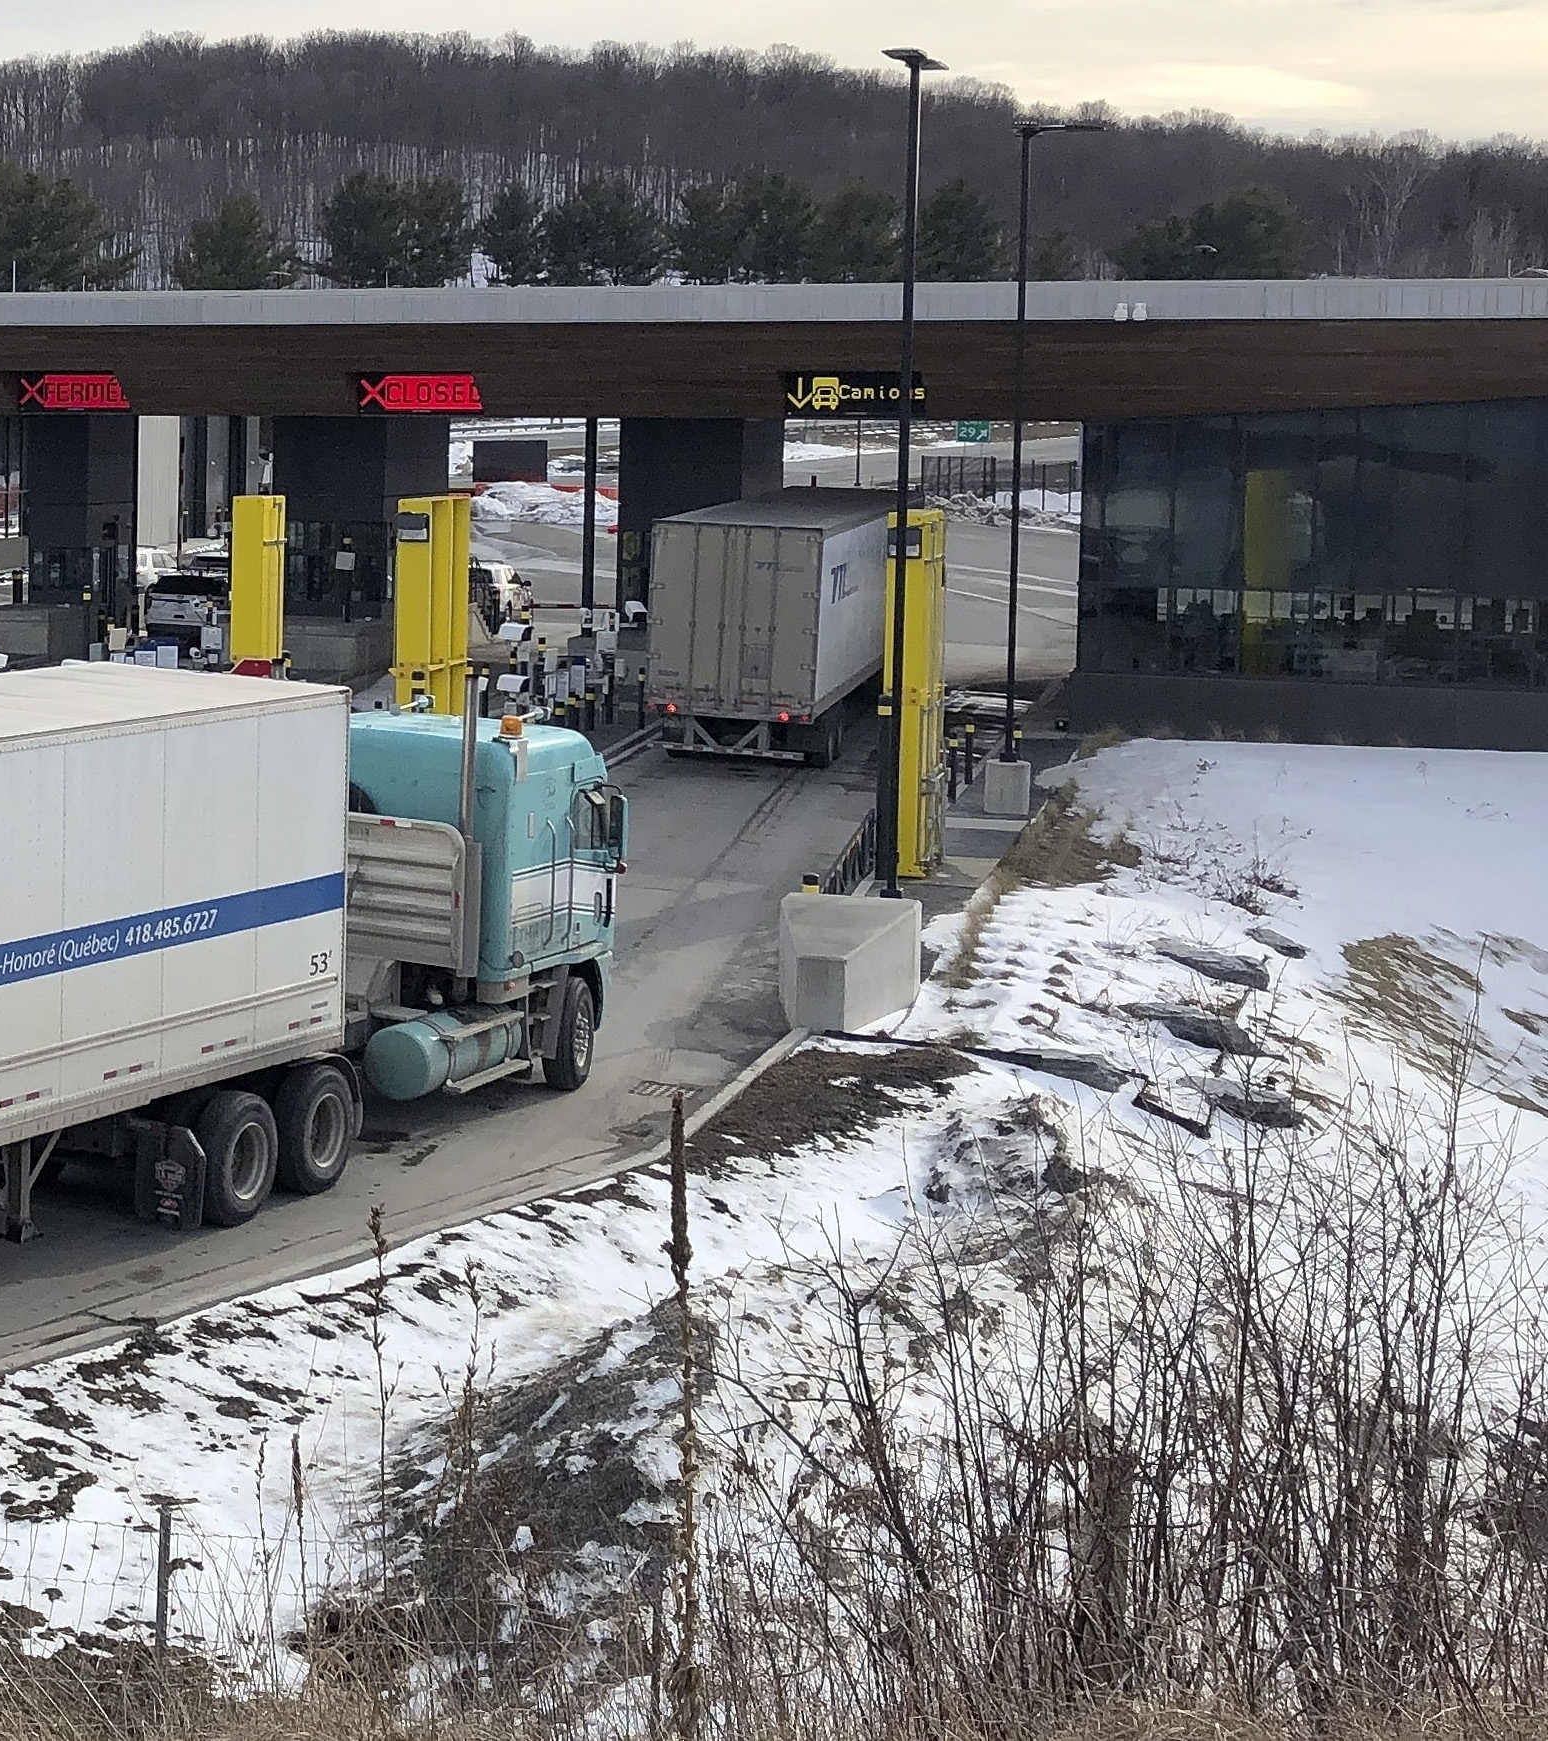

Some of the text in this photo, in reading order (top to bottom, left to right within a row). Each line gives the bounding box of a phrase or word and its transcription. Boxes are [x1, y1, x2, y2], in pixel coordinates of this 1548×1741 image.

[838, 385, 925, 401] Camios
[959, 426, 977, 438] 29
[58, 928, 120, 965] (Québec)
[124, 908, 219, 947] 418.485.6727
